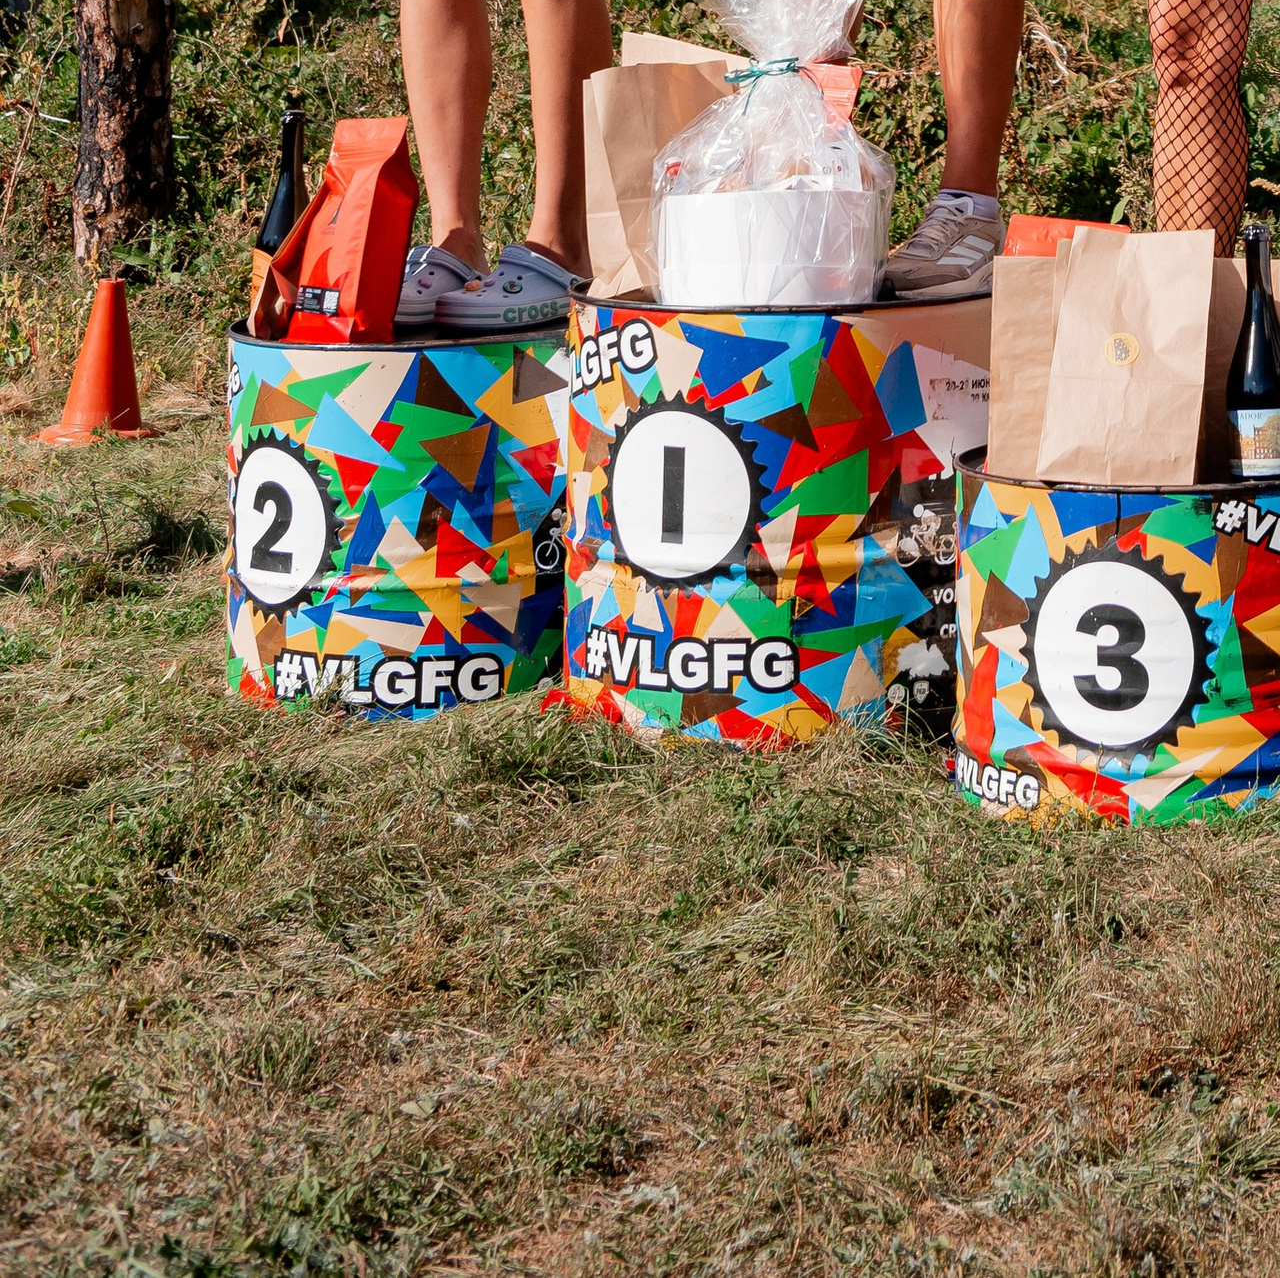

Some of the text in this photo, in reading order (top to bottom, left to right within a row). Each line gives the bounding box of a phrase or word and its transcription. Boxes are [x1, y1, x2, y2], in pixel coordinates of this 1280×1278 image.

[503, 301, 559, 323] crocs
[250, 480, 294, 575] 2
[276, 652, 500, 705] #VLGFG
[586, 629, 796, 691] #VLGFG
[1073, 603, 1150, 712] 3
